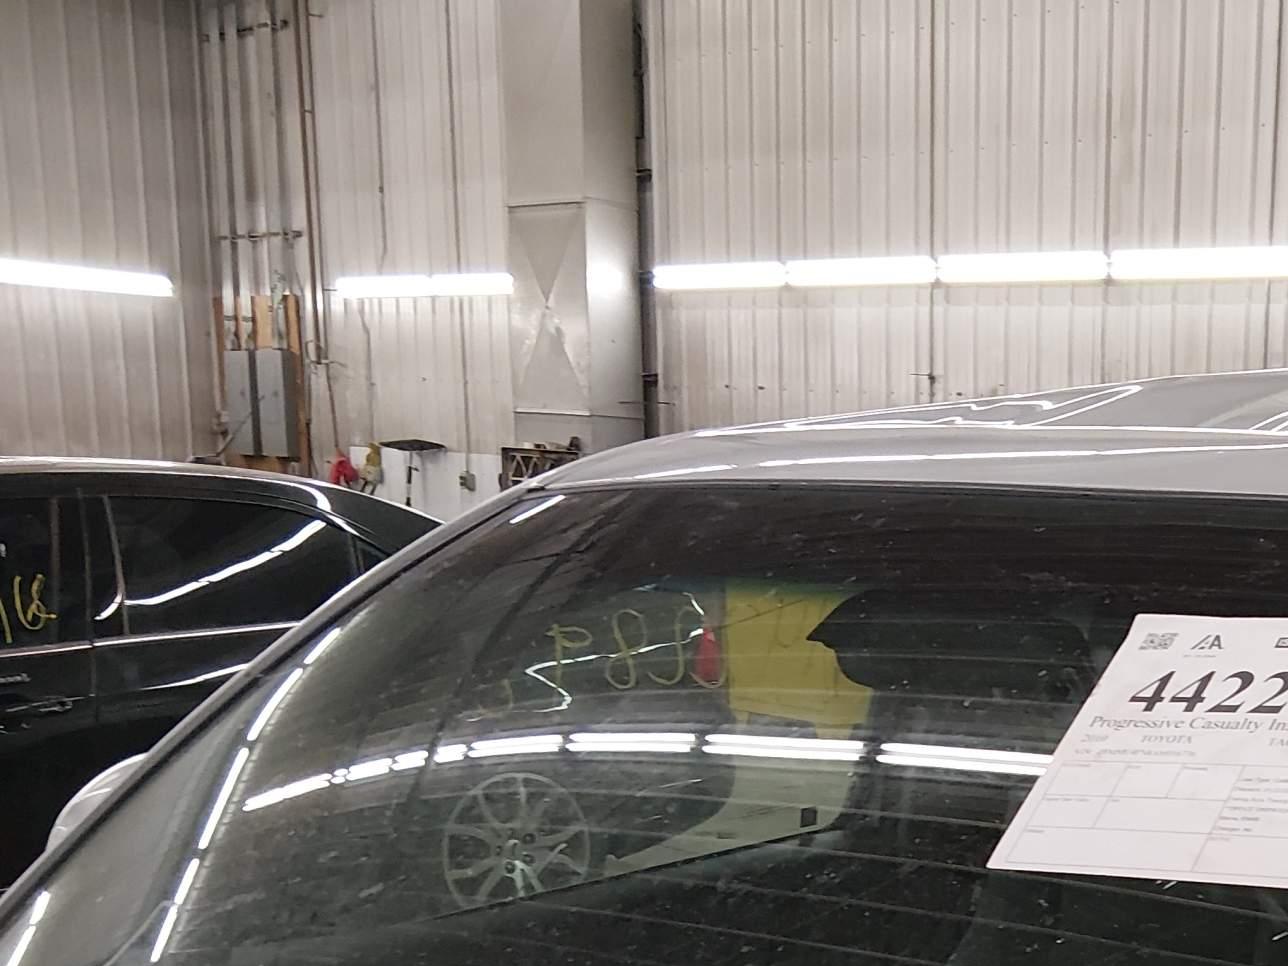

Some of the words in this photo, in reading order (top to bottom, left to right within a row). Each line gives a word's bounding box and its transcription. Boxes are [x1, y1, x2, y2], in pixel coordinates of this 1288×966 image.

[1089, 715, 1185, 731] Progressive
[1189, 717, 1262, 734] Casualty
[1140, 734, 1193, 745] TOYOTA
